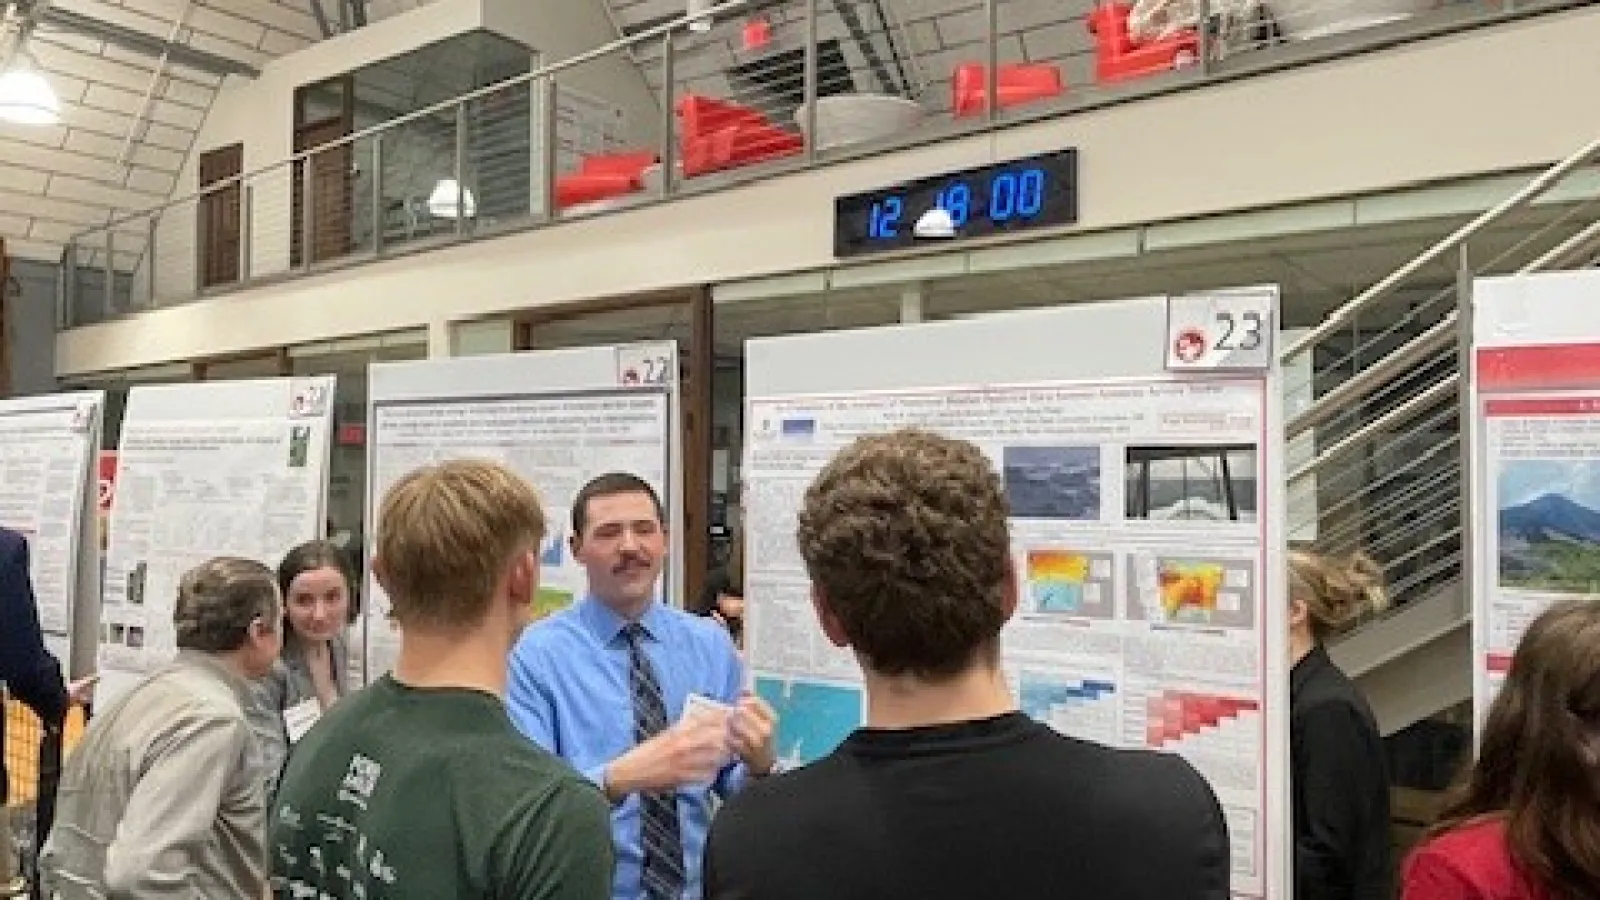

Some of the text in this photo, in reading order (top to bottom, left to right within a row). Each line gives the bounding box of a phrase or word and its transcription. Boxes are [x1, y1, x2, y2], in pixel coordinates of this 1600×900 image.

[868, 197, 903, 238] 12
[990, 169, 1043, 221] 00
[1213, 312, 1263, 351] 23
[642, 356, 669, 384] 22
